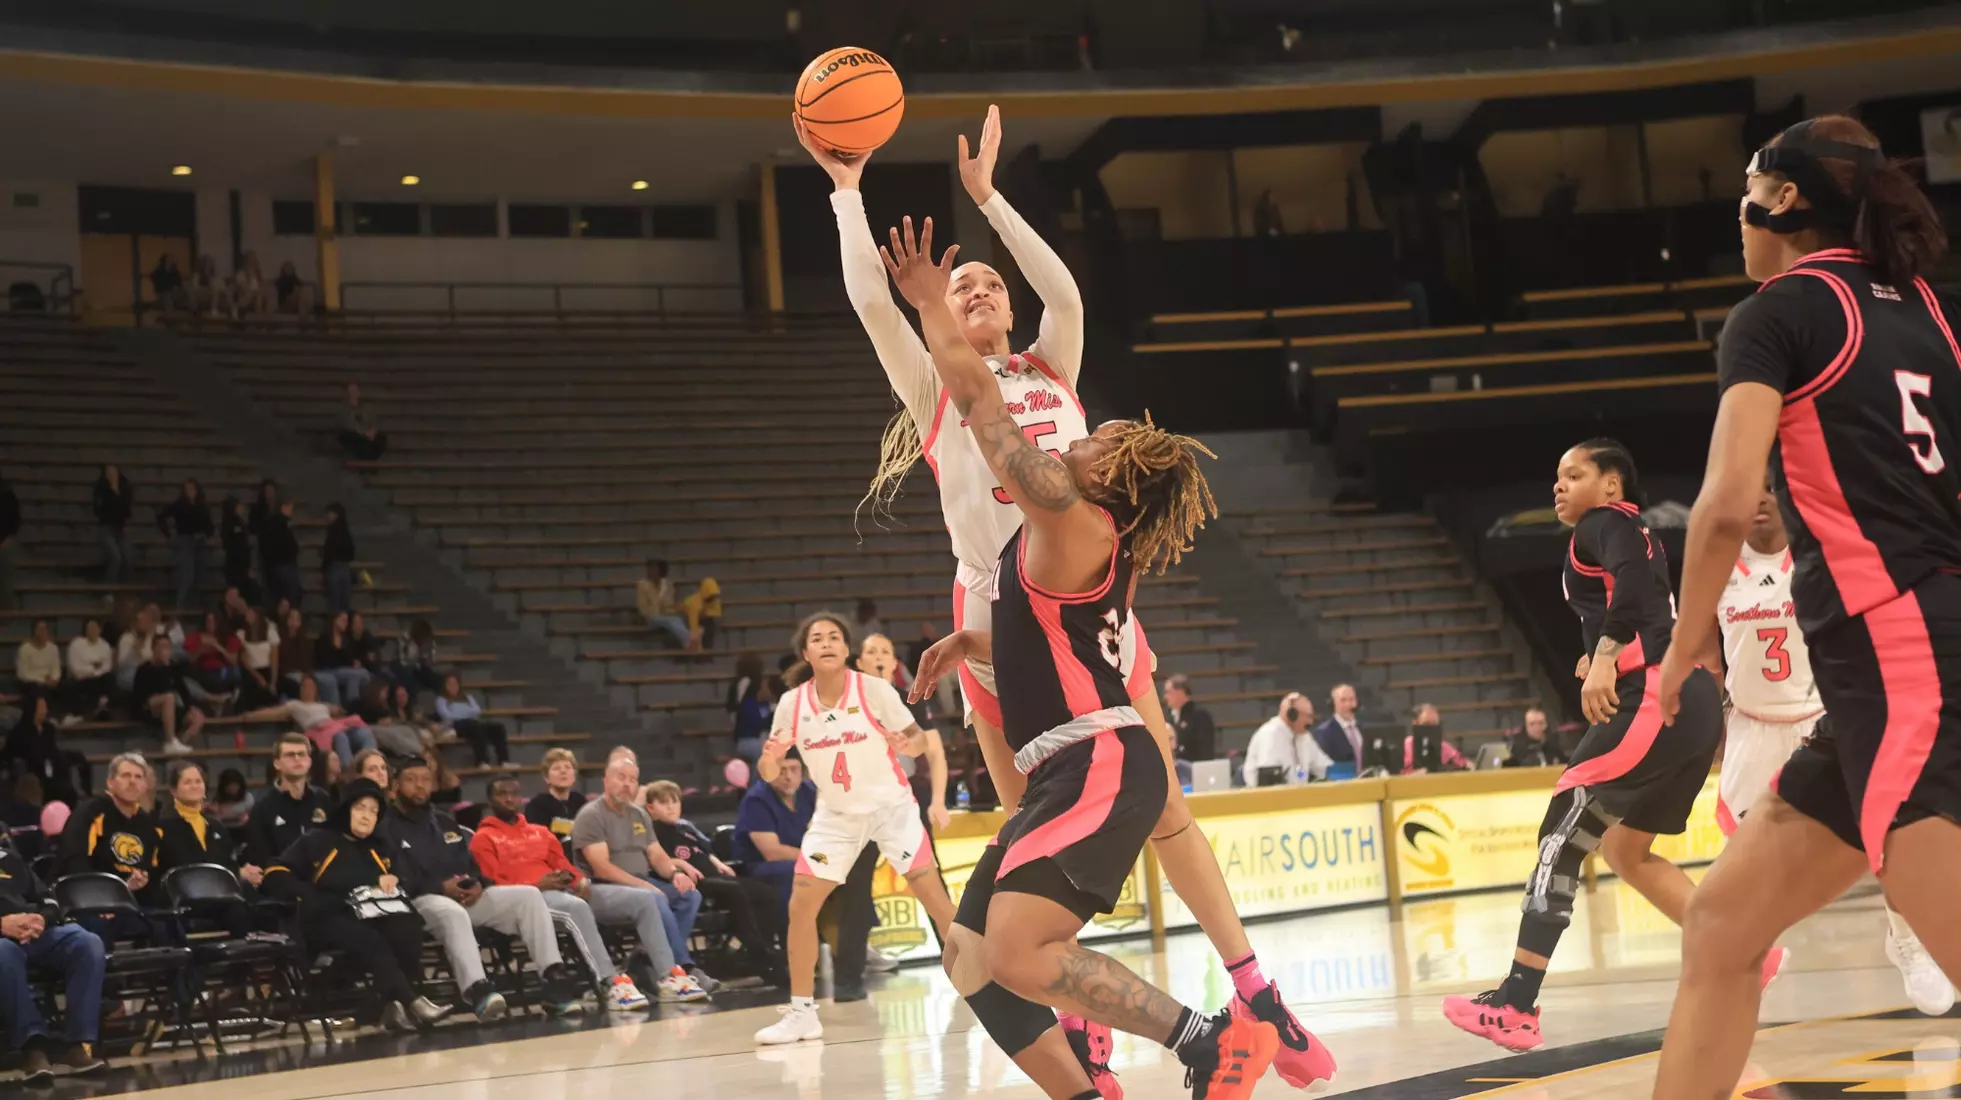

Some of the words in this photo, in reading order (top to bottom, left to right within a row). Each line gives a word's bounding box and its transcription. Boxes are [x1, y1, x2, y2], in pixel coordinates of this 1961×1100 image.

[813, 52, 888, 82] Wilson
[1893, 369, 1945, 474] 5
[1726, 602, 1781, 624] Southern
[1757, 626, 1792, 682] 3
[831, 751, 852, 793] 4
